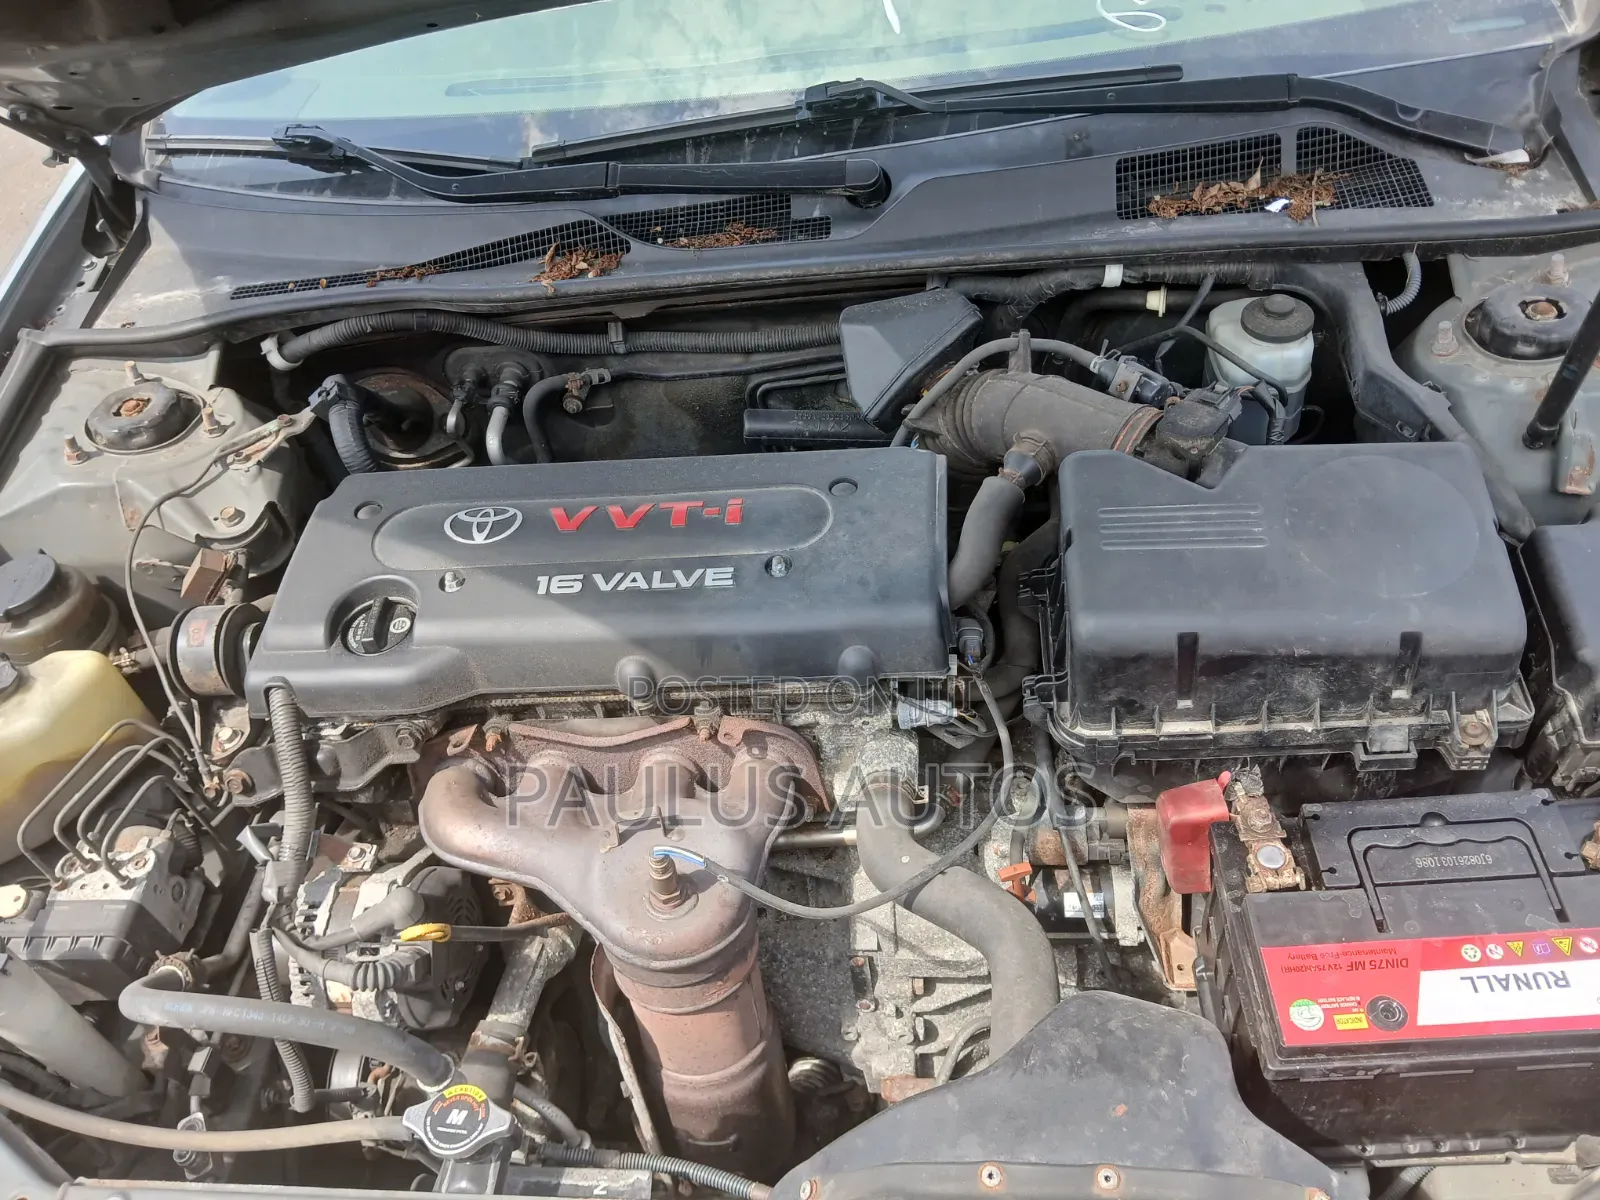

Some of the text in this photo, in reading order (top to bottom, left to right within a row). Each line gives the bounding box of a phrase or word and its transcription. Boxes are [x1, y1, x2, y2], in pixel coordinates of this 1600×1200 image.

[550, 498, 745, 531] VVT-i
[536, 566, 736, 595] 16 VALVE
[1287, 947, 1397, 961] Maintenance-Free Battery
[1346, 960, 1366, 972] MF
[1369, 957, 1409, 970] DIN75
[1459, 970, 1572, 994] RUNALL
[1335, 1016, 1363, 1025] INDICATOR
[454, 1087, 484, 1099] CAUTION
[445, 1108, 469, 1126] M
